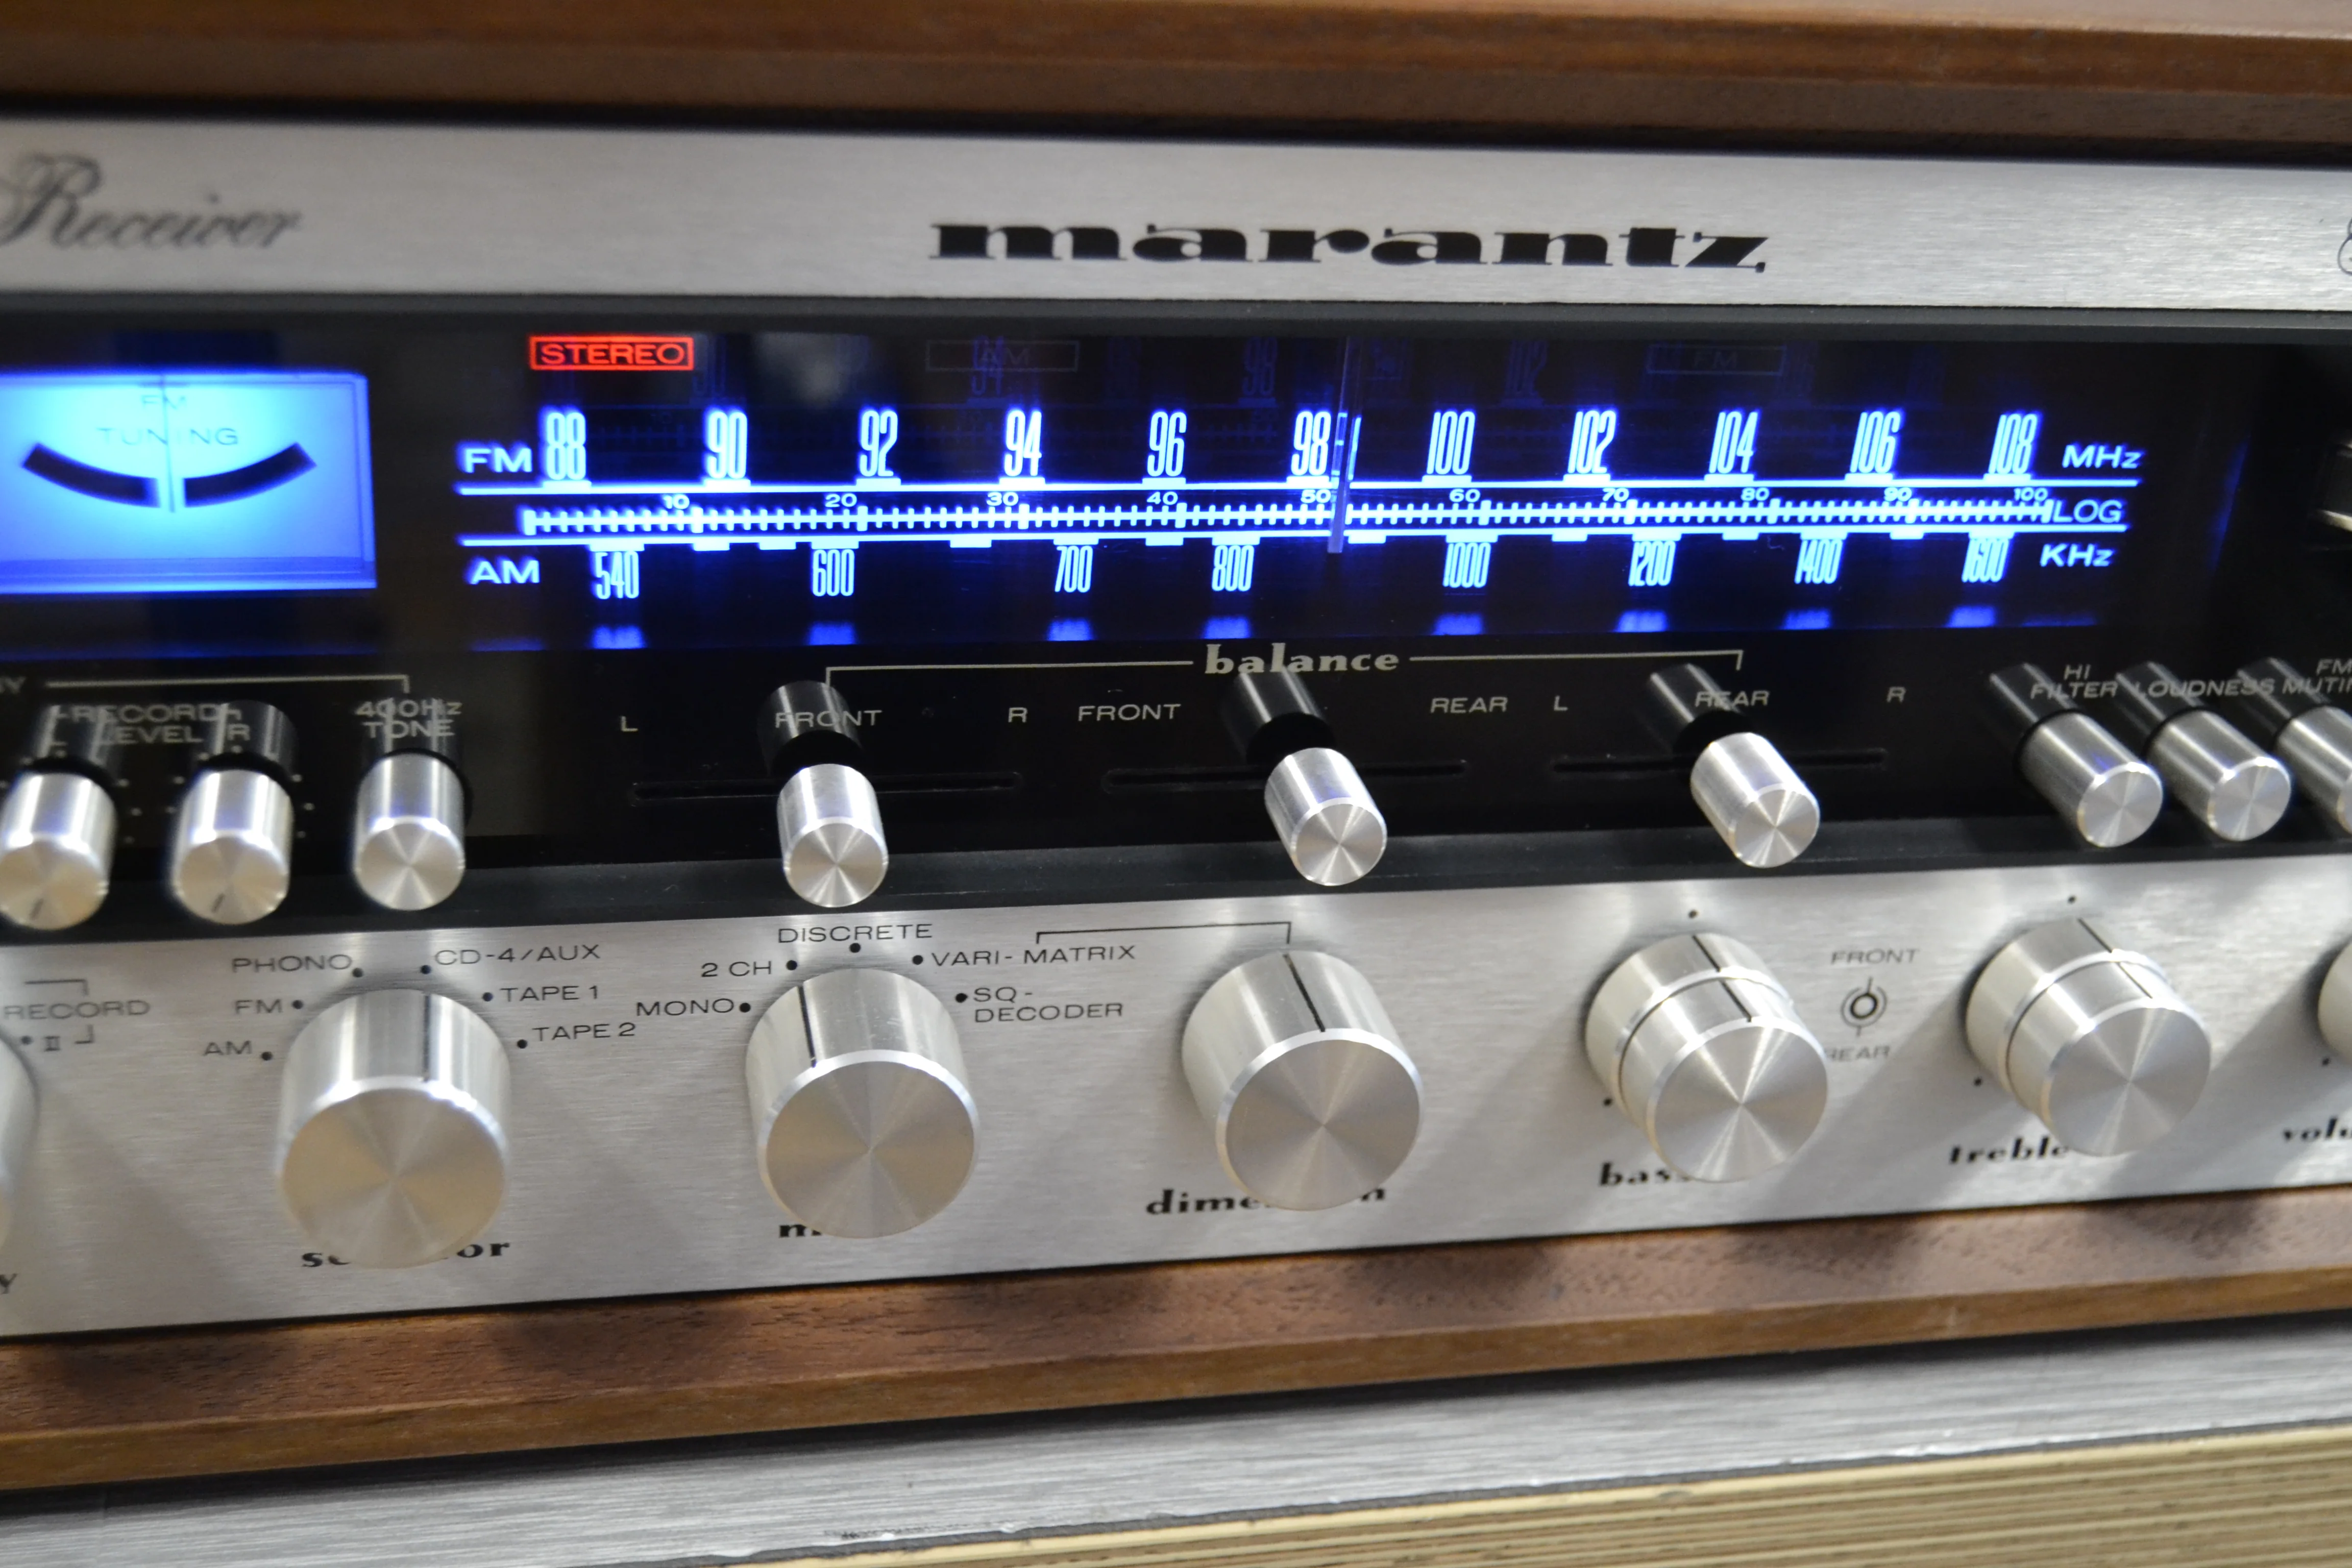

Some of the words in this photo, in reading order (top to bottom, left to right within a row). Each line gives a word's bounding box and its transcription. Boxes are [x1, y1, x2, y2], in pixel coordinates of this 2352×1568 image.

[0, 152, 301, 249] Receiver
[929, 223, 1769, 273] marantz
[541, 342, 685, 365] STEREO
[96, 427, 240, 446] TUNING
[462, 446, 533, 474] FM
[543, 411, 587, 481] 88
[705, 410, 748, 480] 90
[859, 409, 898, 477] 92
[1003, 409, 1043, 477] 94
[1146, 410, 1187, 478] 96
[1291, 410, 1331, 477] 98
[1427, 410, 1476, 475] 100
[1567, 410, 1617, 475] 102
[1709, 410, 1759, 474] 104
[1850, 410, 1901, 474] 106
[1988, 413, 2039, 474] 108
[2062, 444, 2143, 469] MHz
[663, 494, 690, 510] 10
[825, 493, 858, 508] 20
[986, 492, 1019, 507] 30
[1146, 491, 1179, 506] 40
[1301, 488, 1331, 504] 50
[1449, 488, 1481, 503] 60
[1602, 487, 1630, 502] 70
[1741, 487, 1770, 502] 80
[1883, 486, 1913, 502] 90
[2014, 487, 2049, 502] 100
[2052, 499, 2123, 523] LOG
[469, 559, 541, 585] AM
[594, 551, 640, 599] 540
[812, 549, 855, 596] 600
[1054, 545, 1094, 593] 700
[1212, 545, 1255, 592] 800
[1443, 542, 1491, 588] 1000
[1628, 540, 1677, 586] 1200
[1794, 540, 1844, 584] 1400
[2040, 543, 2115, 568] KHz
[1205, 643, 1400, 675] balance
[2063, 665, 2092, 680] HI
[1886, 686, 1906, 702] R
[2030, 681, 2119, 700] FILTER
[2134, 678, 2275, 698] LOUDNESS
[1430, 696, 1509, 714] REAR
[1554, 695, 1569, 711] L
[1694, 690, 1770, 708] REAR
[70, 703, 222, 724] RECORD
[775, 709, 883, 729] FRONT
[1008, 706, 1028, 724] R
[1077, 703, 1182, 722] FRONT
[362, 719, 455, 739] TONE
[620, 716, 639, 732] L
[103, 725, 204, 745] LEVEL
[777, 924, 933, 943] DISCRETE
[231, 954, 353, 973] PHONO
[434, 944, 601, 966] CD-4/AUX
[1830, 947, 1921, 964] FRONT
[700, 962, 718, 978] 2
[728, 960, 772, 976] CH
[500, 986, 580, 1003] TAPE
[589, 985, 599, 1000] 1
[3, 1000, 152, 1020] RECORD
[234, 999, 283, 1015] FM
[635, 998, 735, 1017] MONO
[974, 1003, 1123, 1023] DECODER
[532, 1023, 611, 1042] TAPE
[618, 1022, 637, 1037] 2
[204, 1040, 253, 1057] AM
